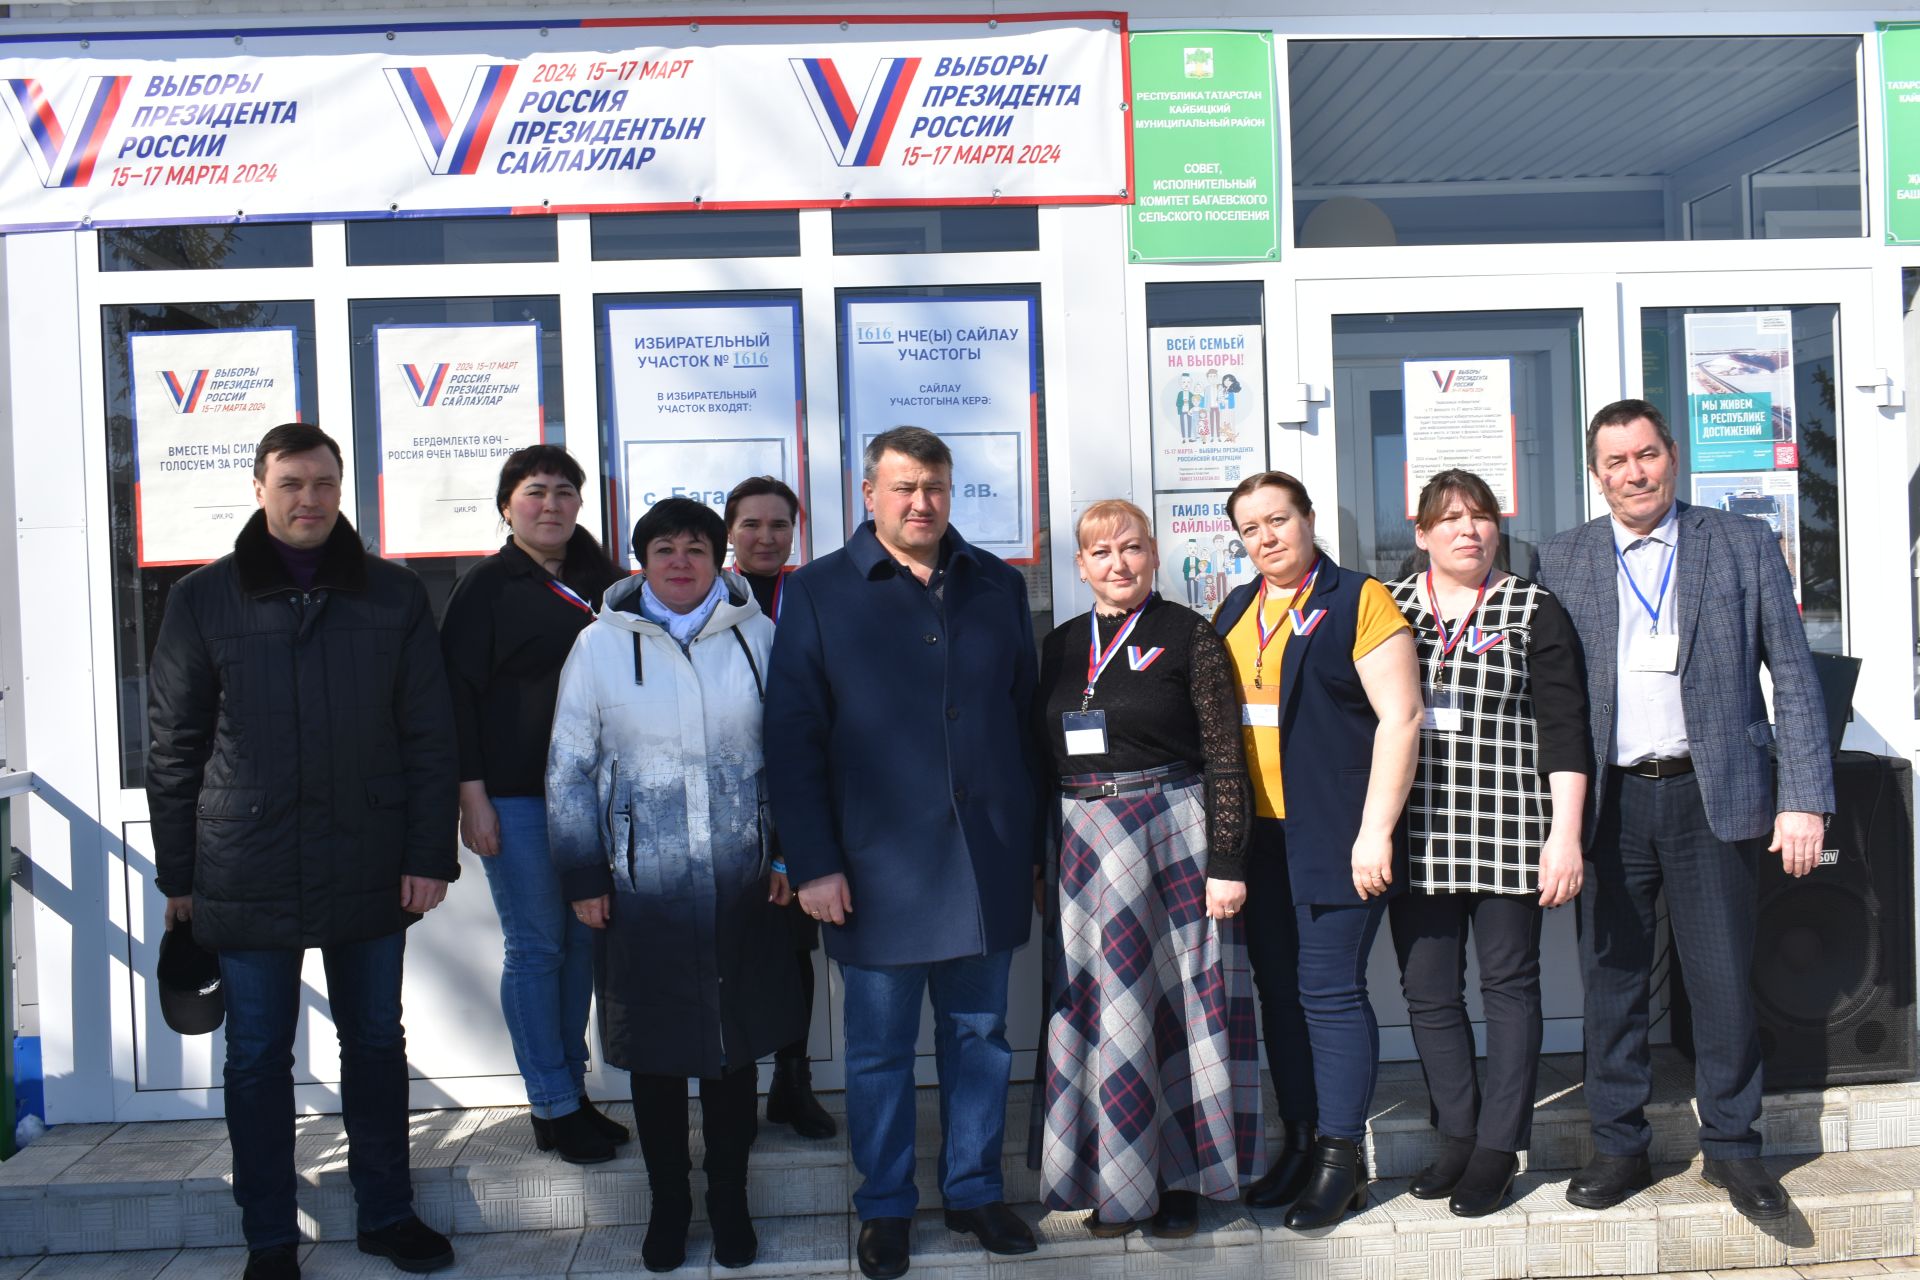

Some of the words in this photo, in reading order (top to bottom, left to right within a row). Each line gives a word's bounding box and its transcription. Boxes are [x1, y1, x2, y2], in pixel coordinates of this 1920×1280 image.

[532, 63, 577, 83] 2024
[639, 60, 694, 81] МАРТ
[934, 54, 1048, 77] ВЫБОРЫ
[144, 73, 264, 97] ВЫБОРЫ
[518, 89, 629, 113] РОССИЯ
[922, 84, 1082, 109] ПРЕЗИДЕНТА
[1136, 91, 1204, 101] РЕСПУБЛИКА
[1205, 91, 1262, 100] ТАТАРСТАН
[131, 101, 298, 128] ПРЕЗИДЕНТА
[1169, 103, 1231, 115] КАЙБИЦКИЙ
[910, 115, 1014, 139] РОССИИ
[1135, 117, 1230, 130] МУНИЦИПАЛЬНЫЙ
[1231, 116, 1265, 127] РАЙОН
[507, 117, 706, 145] ПРЕЗИДЕНТЫН
[118, 134, 227, 159] РОССИИ
[496, 147, 656, 174] САЙЛАУЛАР
[953, 145, 1014, 165] МАРТА
[1017, 144, 1061, 164] 2024
[164, 165, 230, 186] МАРТА
[232, 163, 278, 184] 2024
[1184, 163, 1223, 175] СОВЕТ,
[1153, 176, 1256, 190] ИСПОЛНИТЕЛЬНЫЙ
[1140, 195, 1189, 207] КОМИТЕТ
[1192, 194, 1267, 206] БАГАЕВСКОГО
[1138, 211, 1202, 223] СЕЛЬСКОГО
[1205, 210, 1270, 221] ПОСЕЛЕНИЯ
[634, 332, 770, 349] ИЗБИРАТЕЛЬНЫЙ
[857, 327, 892, 341] 1616
[898, 329, 952, 344] НЧЕ(Ы)
[956, 326, 1018, 342] САЙЛАУ
[1166, 335, 1196, 351] ВСЕЙ
[1200, 334, 1245, 350] СЕМЬЕЙ
[638, 355, 709, 368] УЧАСТОК
[733, 351, 768, 366] 1616
[898, 348, 981, 361] УЧАСТОГЫ
[1168, 355, 1183, 367] НА
[1187, 353, 1244, 367] ВЫБОРЫ!
[214, 367, 260, 378] ВЫБОРЫ
[455, 363, 474, 371] 2024
[497, 361, 518, 370] МАРТ
[210, 379, 274, 390] ПРЕЗИДЕНТА
[450, 374, 491, 384] РОССИЯ
[446, 384, 520, 395] ПРЕЗИДЕНТЫН
[657, 392, 664, 401] В
[666, 389, 757, 401] ИЗБИРАТЕЛЬНЫЙ
[919, 383, 961, 394] САЙЛАУ
[205, 392, 247, 402] РОССИИ
[441, 395, 504, 406] САЙЛАУЛАР
[889, 397, 960, 407] УЧАСТОГЫНА
[962, 396, 992, 406] КЕРӘ:
[222, 403, 247, 412] МАРТА
[248, 403, 266, 411] 2024
[658, 404, 706, 414] УЧАСТОК
[708, 403, 752, 413] ВХОДЯТ:
[1702, 400, 1717, 411] МЫ
[1720, 399, 1753, 410] ЖИВЕМ
[1702, 413, 1708, 424] В
[1711, 411, 1766, 424] РЕСПУБЛИКЕ
[1703, 423, 1762, 439] ДОСТИЖЕНИЙ
[413, 436, 480, 447] БЕРДӘМЛЕКТӘ
[482, 435, 502, 445] КӨЧ
[168, 445, 209, 457] ВМЕСТЕ
[211, 444, 231, 455] МЫ
[388, 450, 424, 460] РОССИЯ
[426, 449, 451, 459] ӨЧЕН
[454, 448, 488, 459] ТАВЫШ
[160, 460, 215, 472] ГОЛОСУЕМ
[217, 459, 231, 469] ЗА
[233, 458, 255, 469] РОС
[963, 483, 998, 498] ав.
[1172, 504, 1209, 517] ГАИЛӘ
